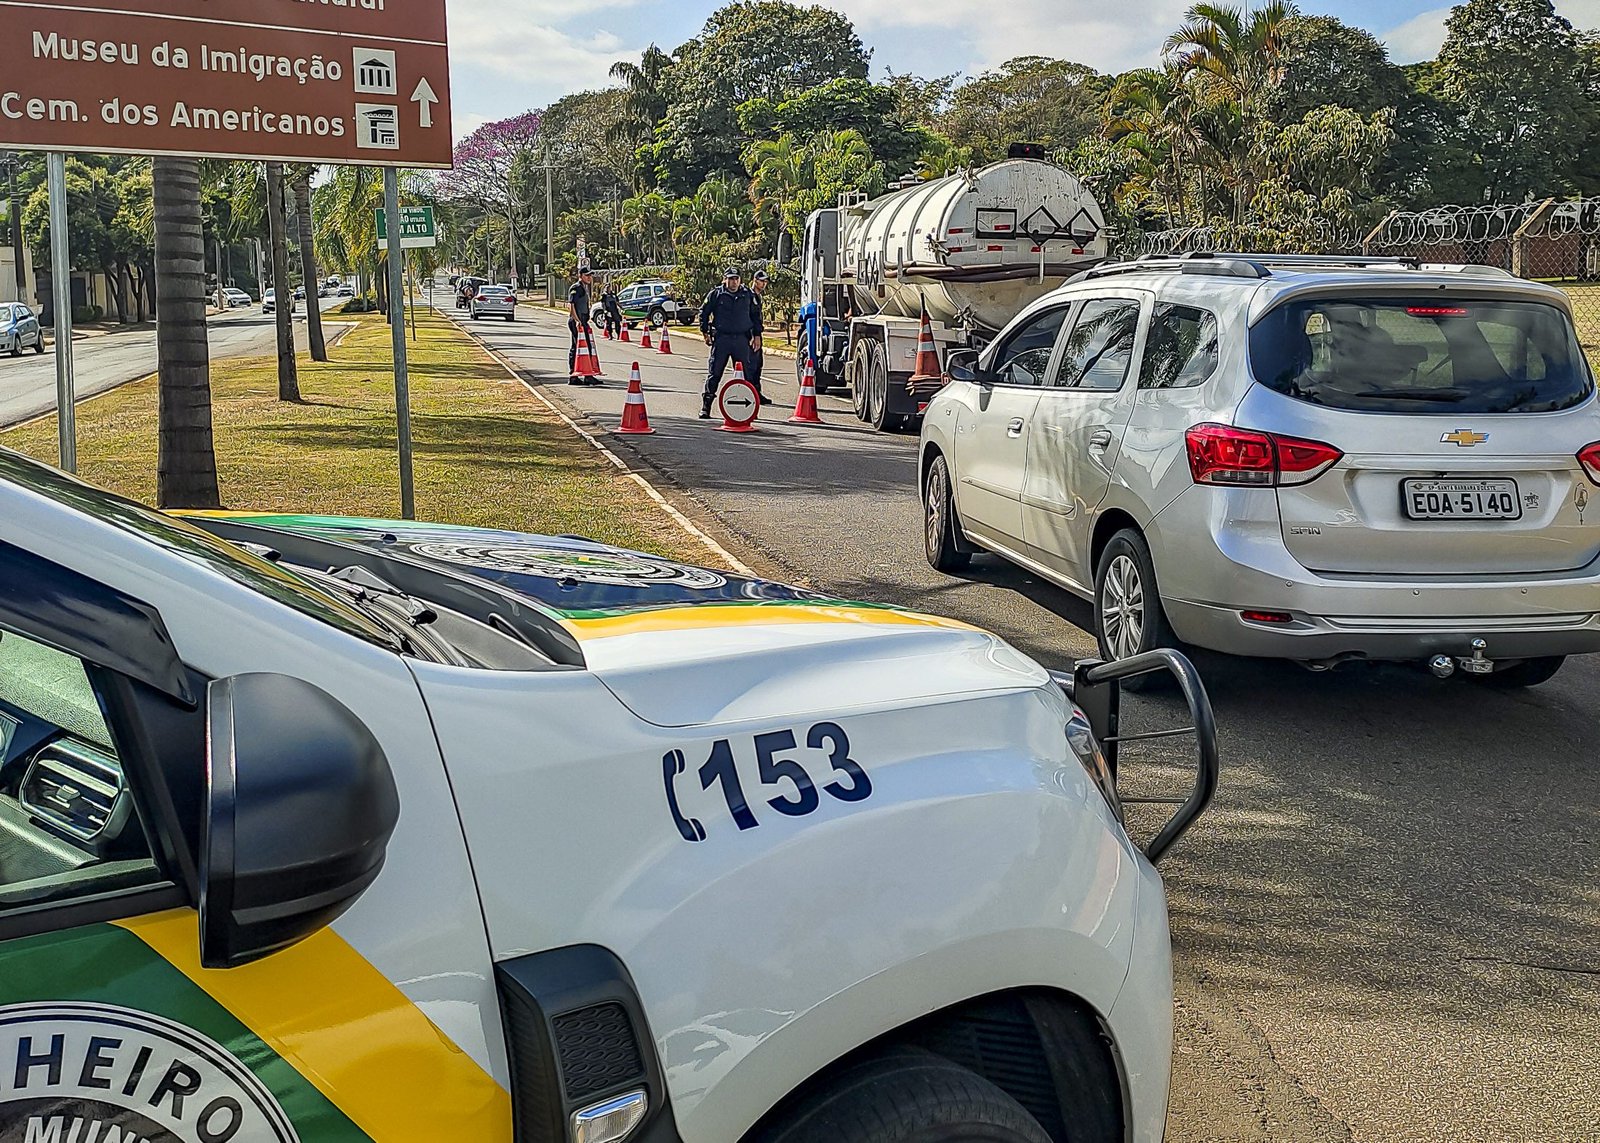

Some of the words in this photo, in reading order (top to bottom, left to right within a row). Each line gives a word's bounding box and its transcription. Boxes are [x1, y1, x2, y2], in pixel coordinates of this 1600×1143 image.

[32, 31, 139, 65] Museu
[151, 41, 189, 69] da
[201, 44, 342, 84] Imigração
[1, 91, 88, 122] Cem.
[101, 97, 159, 126] dos
[170, 101, 345, 137] Americanos
[407, 224, 428, 233] ALTO
[698, 721, 873, 832] 153
